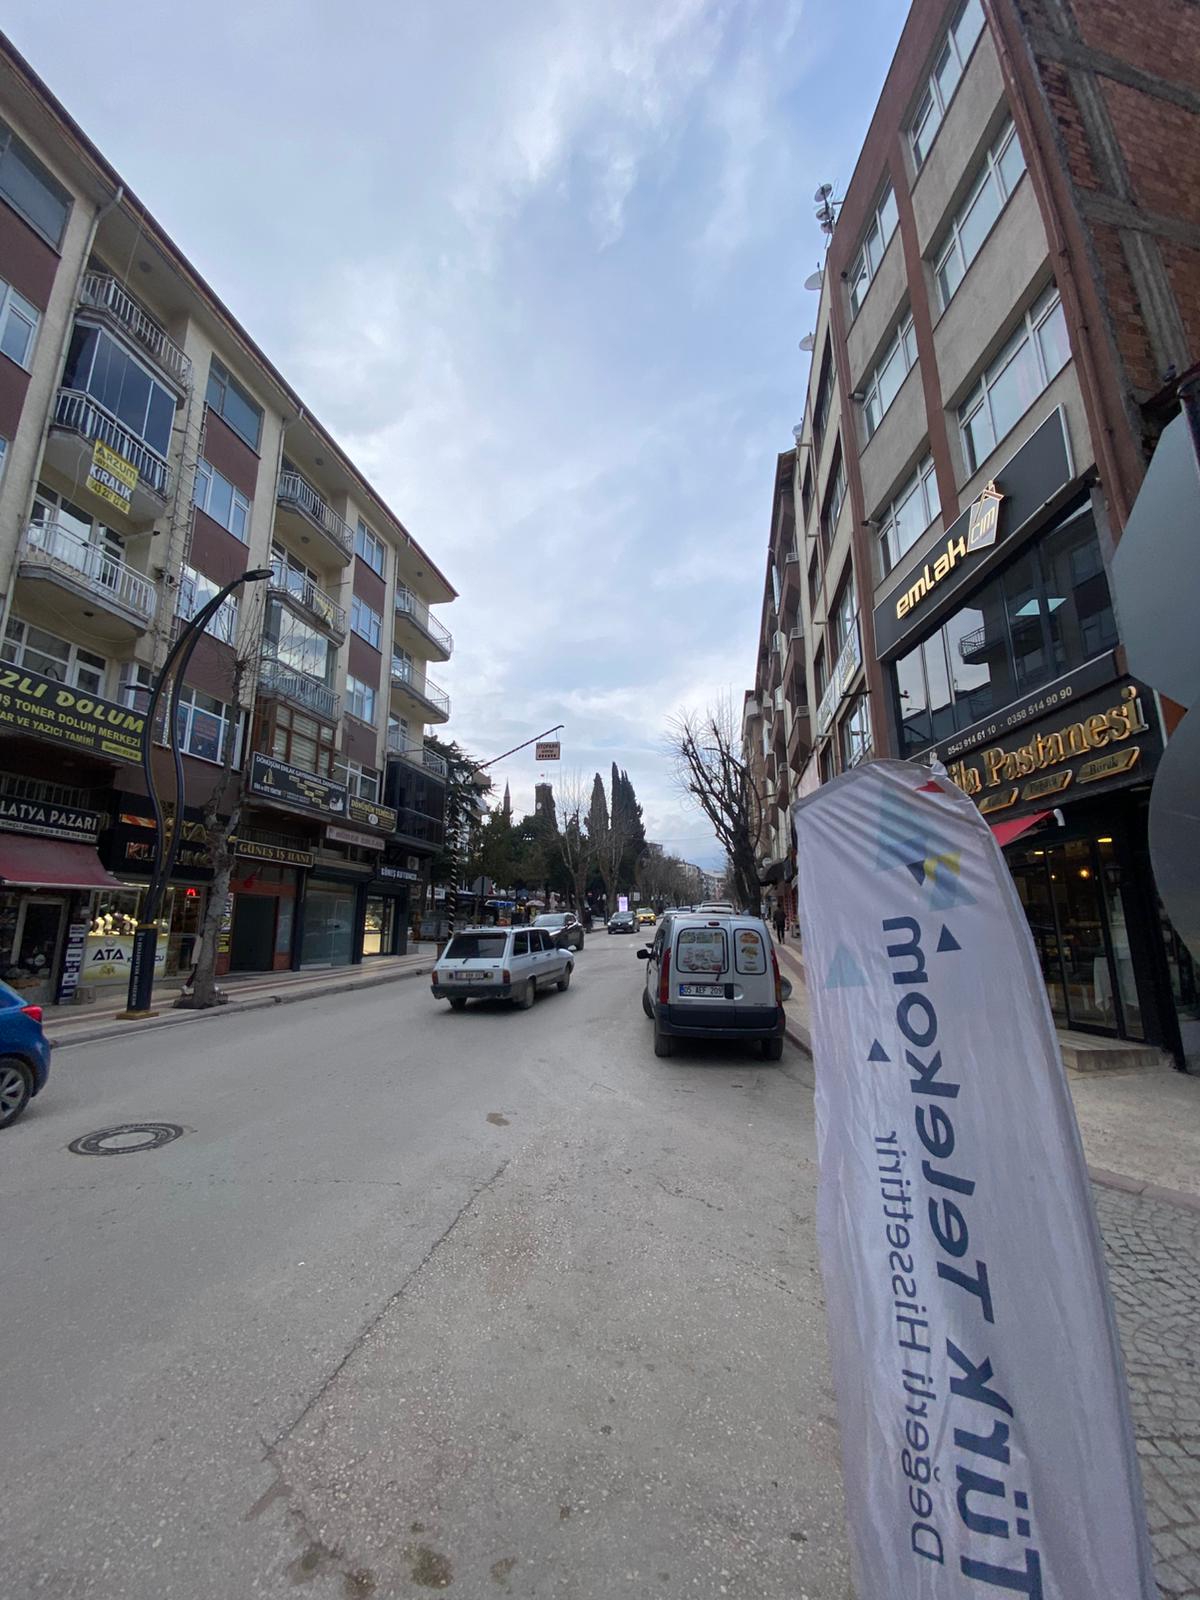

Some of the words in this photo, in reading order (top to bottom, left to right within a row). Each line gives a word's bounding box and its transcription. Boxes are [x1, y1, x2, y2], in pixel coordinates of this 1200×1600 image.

[896, 535, 967, 620] emlak
[0, 668, 48, 697] ZLI
[56, 690, 145, 733] DOLUM
[15, 698, 56, 720] TONER
[58, 713, 97, 733] DOLUM
[98, 727, 141, 748] MERKEZİ
[963, 735, 976, 748] 914
[976, 730, 986, 742] 61
[987, 724, 997, 736] 10
[1006, 709, 1027, 726] 0358
[1028, 700, 1044, 715] 514
[1046, 693, 1058, 706] 90
[1060, 686, 1073, 699] 90
[16, 715, 30, 727] VE
[32, 719, 63, 737] YAZICI
[981, 686, 1149, 787] Pastanesi
[50, 810, 98, 831] PAZARI
[240, 843, 273, 858] GÜNEŞ
[276, 847, 285, 860] İŞ
[287, 852, 310, 864] HANI
[93, 949, 124, 960] ATA
